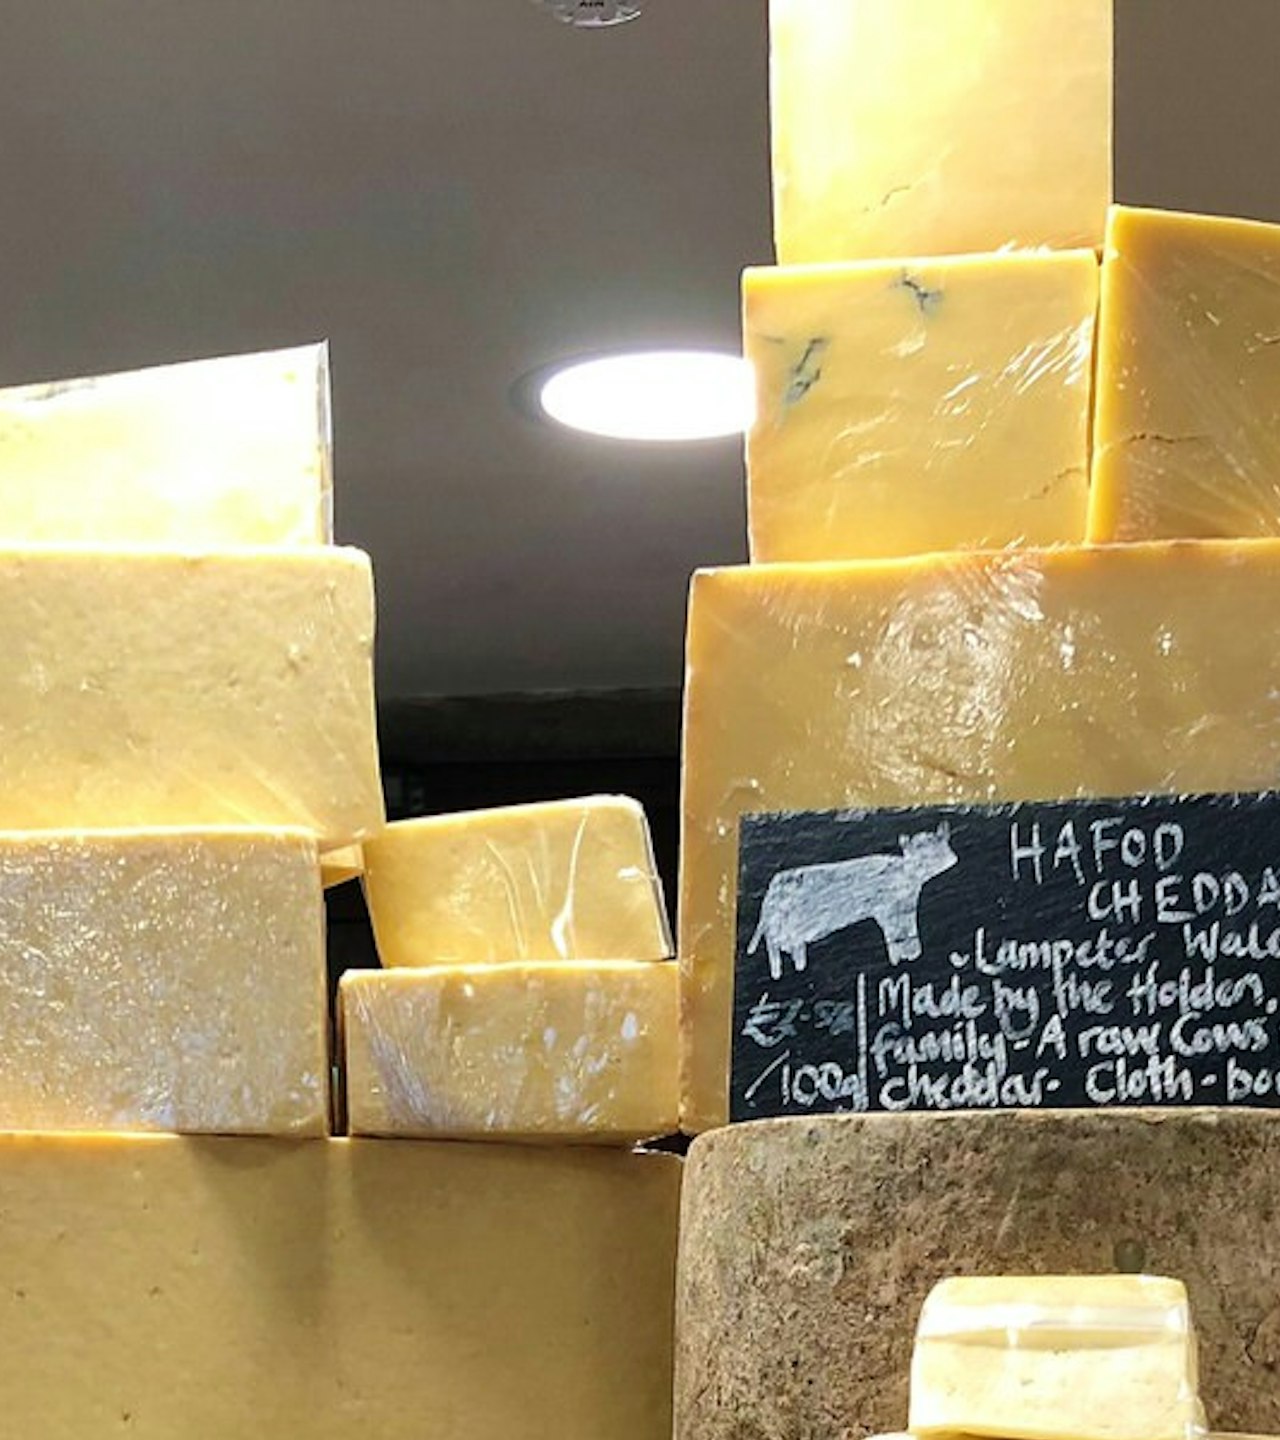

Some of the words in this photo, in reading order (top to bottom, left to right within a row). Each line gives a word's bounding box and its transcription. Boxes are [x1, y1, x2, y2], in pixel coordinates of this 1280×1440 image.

[1010, 816, 1185, 885] HAFOD
[879, 972, 988, 1029] Made
[992, 978, 1041, 1041] by
[1036, 1013, 1068, 1061] A
[1078, 1022, 1163, 1058] raw
